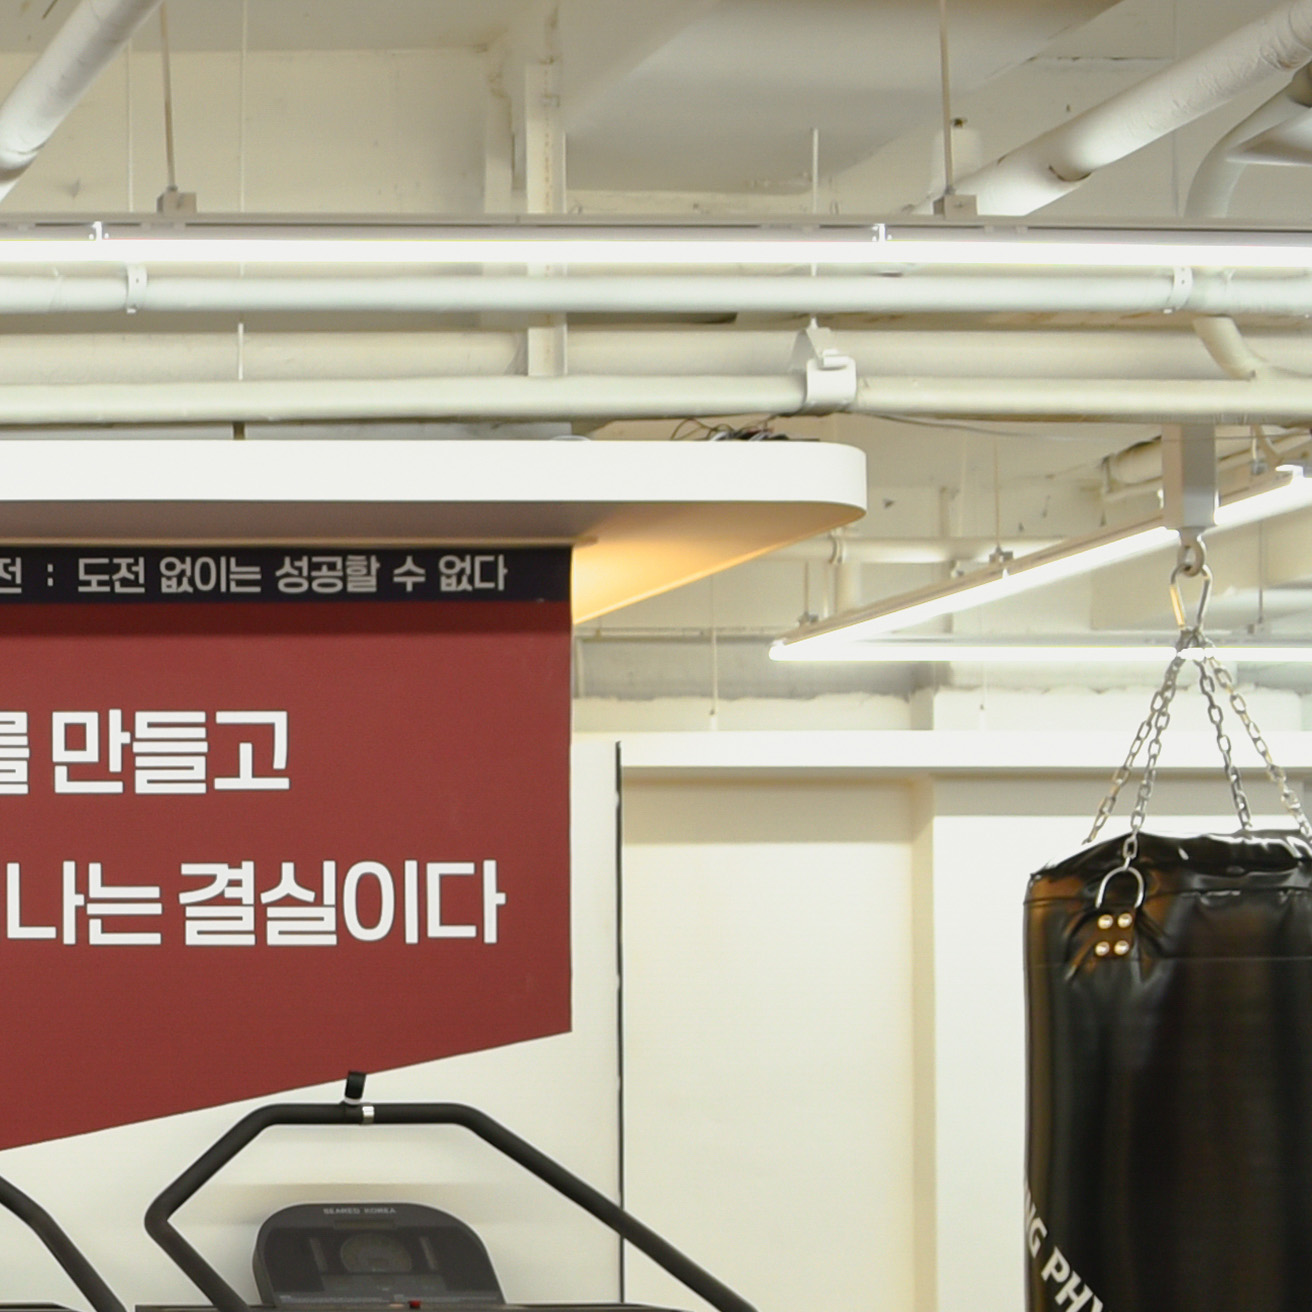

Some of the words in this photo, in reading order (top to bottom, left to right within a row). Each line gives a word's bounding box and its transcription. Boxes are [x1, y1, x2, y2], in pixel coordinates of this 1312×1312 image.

[77, 556, 146, 594] 도전
[159, 556, 262, 594] 없이는
[275, 555, 381, 594] 성공할
[393, 556, 426, 592] 수
[438, 554, 508, 592] 없다
[51, 708, 290, 795] 만들고
[178, 859, 506, 946] 결실이다
